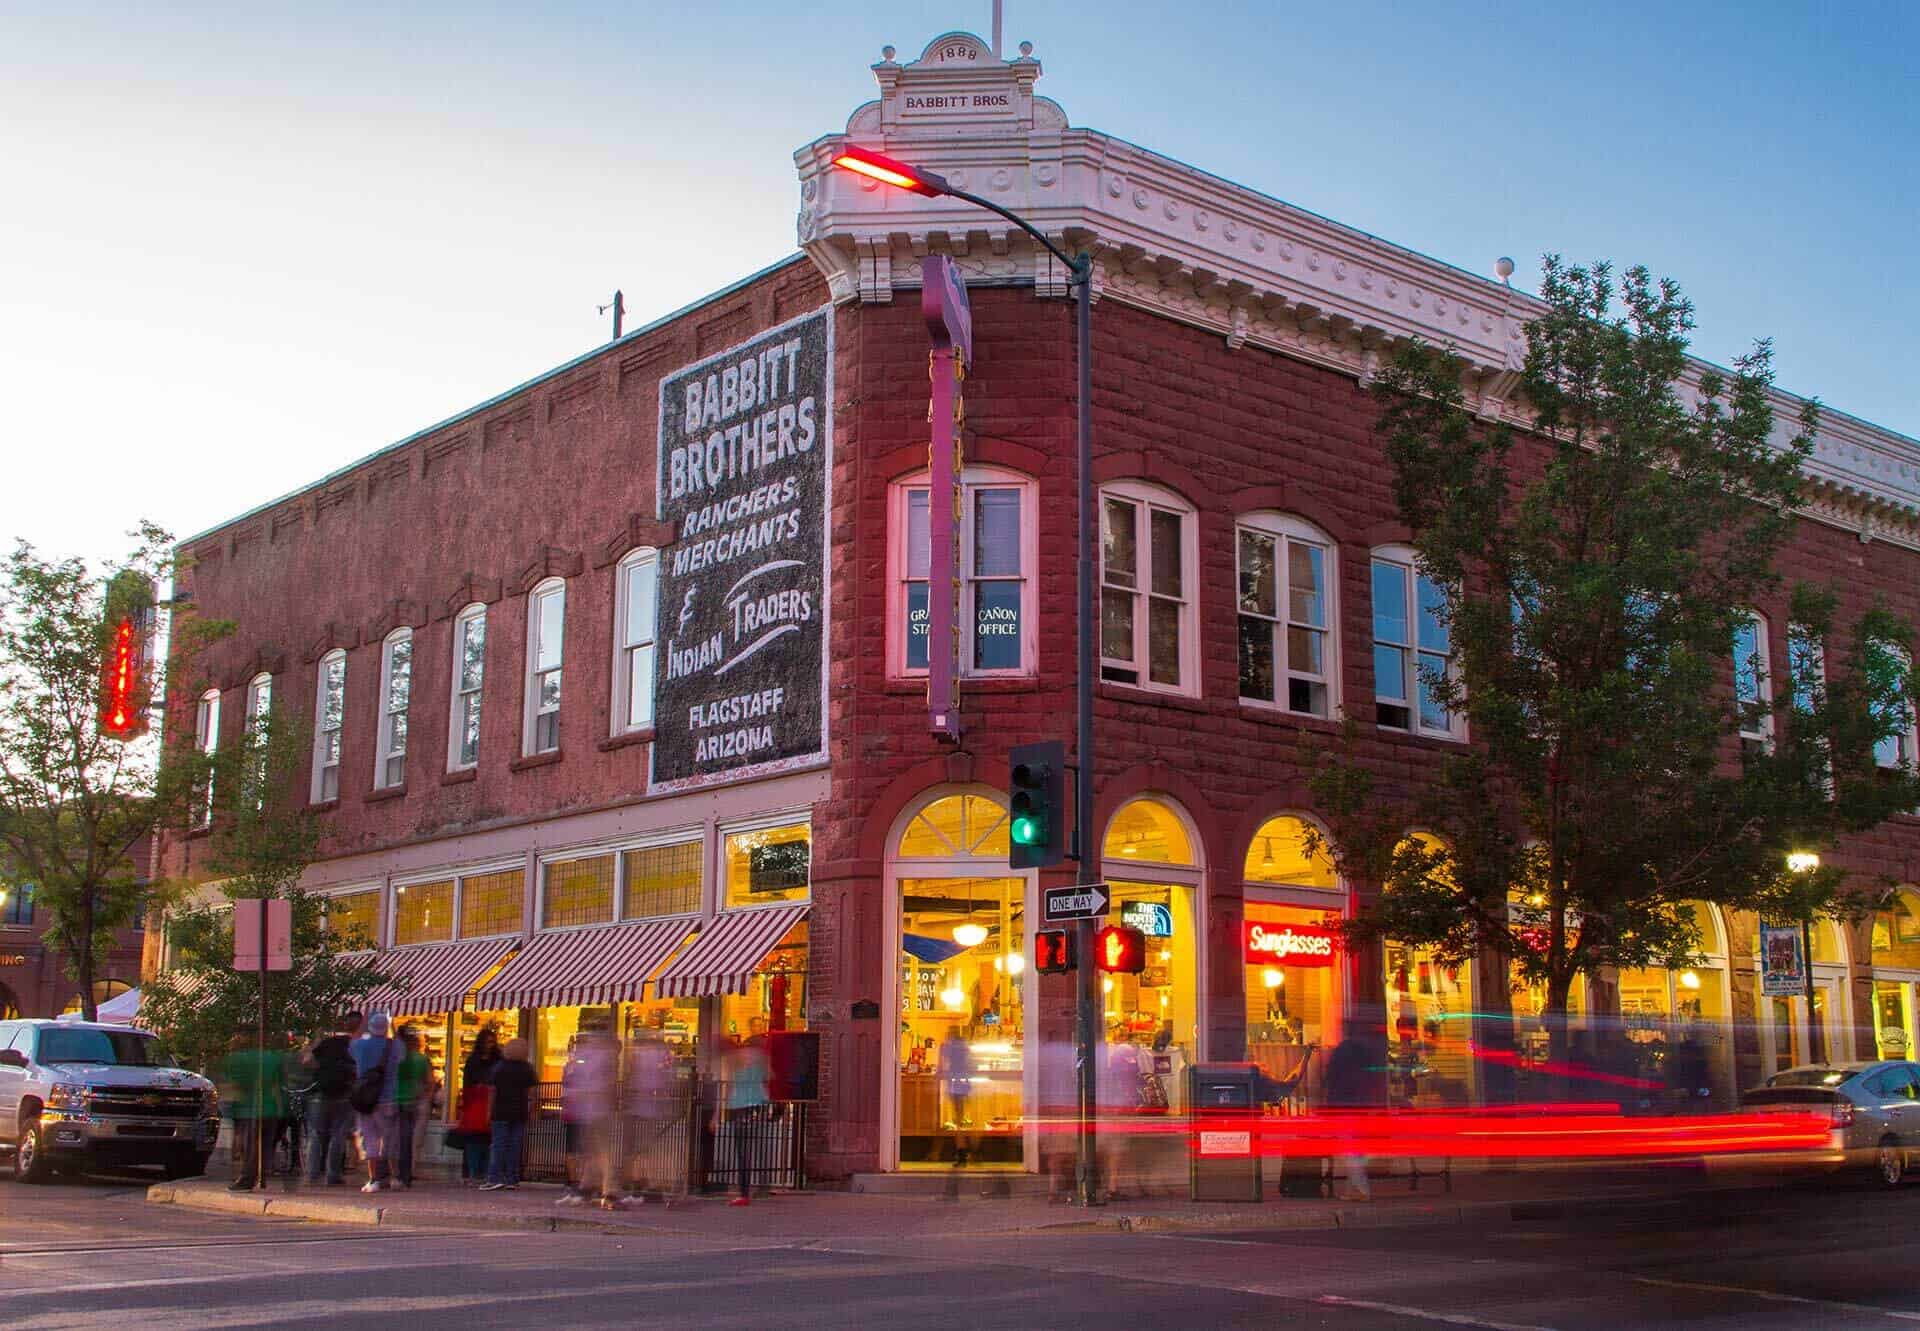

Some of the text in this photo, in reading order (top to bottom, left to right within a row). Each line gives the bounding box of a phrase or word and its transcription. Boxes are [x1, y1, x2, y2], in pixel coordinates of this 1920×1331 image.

[940, 47, 976, 62] 1888
[906, 96, 968, 109] BABBITT
[685, 337, 801, 434] BABBITT
[671, 396, 816, 499] BROTHERS
[672, 508, 801, 577] MERCHANTS
[978, 606, 1017, 621] CAÑON
[978, 623, 1017, 635] OFFICE
[667, 589, 811, 681] INDIAN TRADERS
[689, 688, 784, 730] FLAGSTAFF
[695, 725, 773, 762] ARIZONA
[1051, 895, 1093, 911] ONE WAY
[1123, 912, 1155, 925] NORTH
[1249, 925, 1331, 958] Sunglasses
